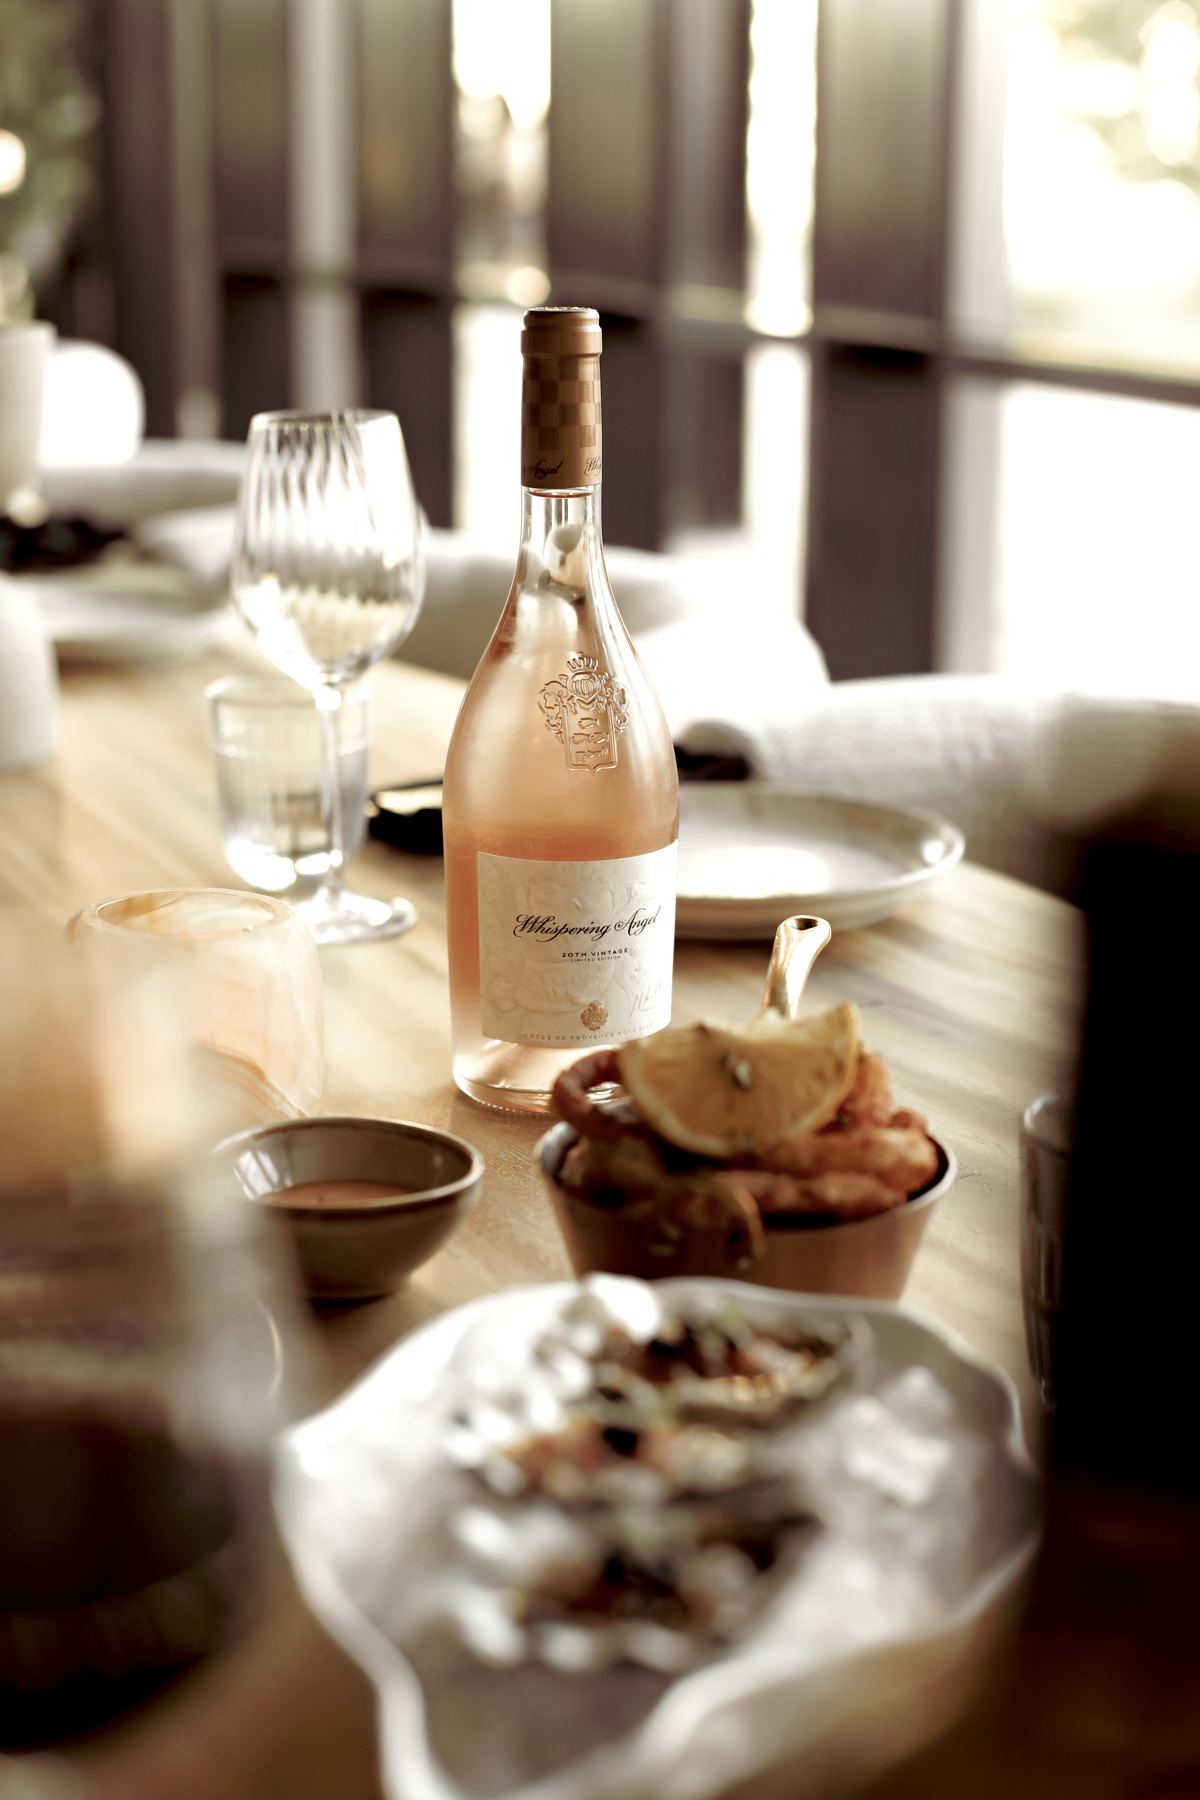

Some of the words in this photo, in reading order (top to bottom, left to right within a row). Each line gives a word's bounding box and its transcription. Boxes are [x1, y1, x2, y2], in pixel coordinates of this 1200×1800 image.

[512, 913, 610, 943] Whispering
[613, 904, 662, 937] Angel
[590, 947, 629, 957] VINTAGE
[570, 1031, 614, 1041] PROVENCE
